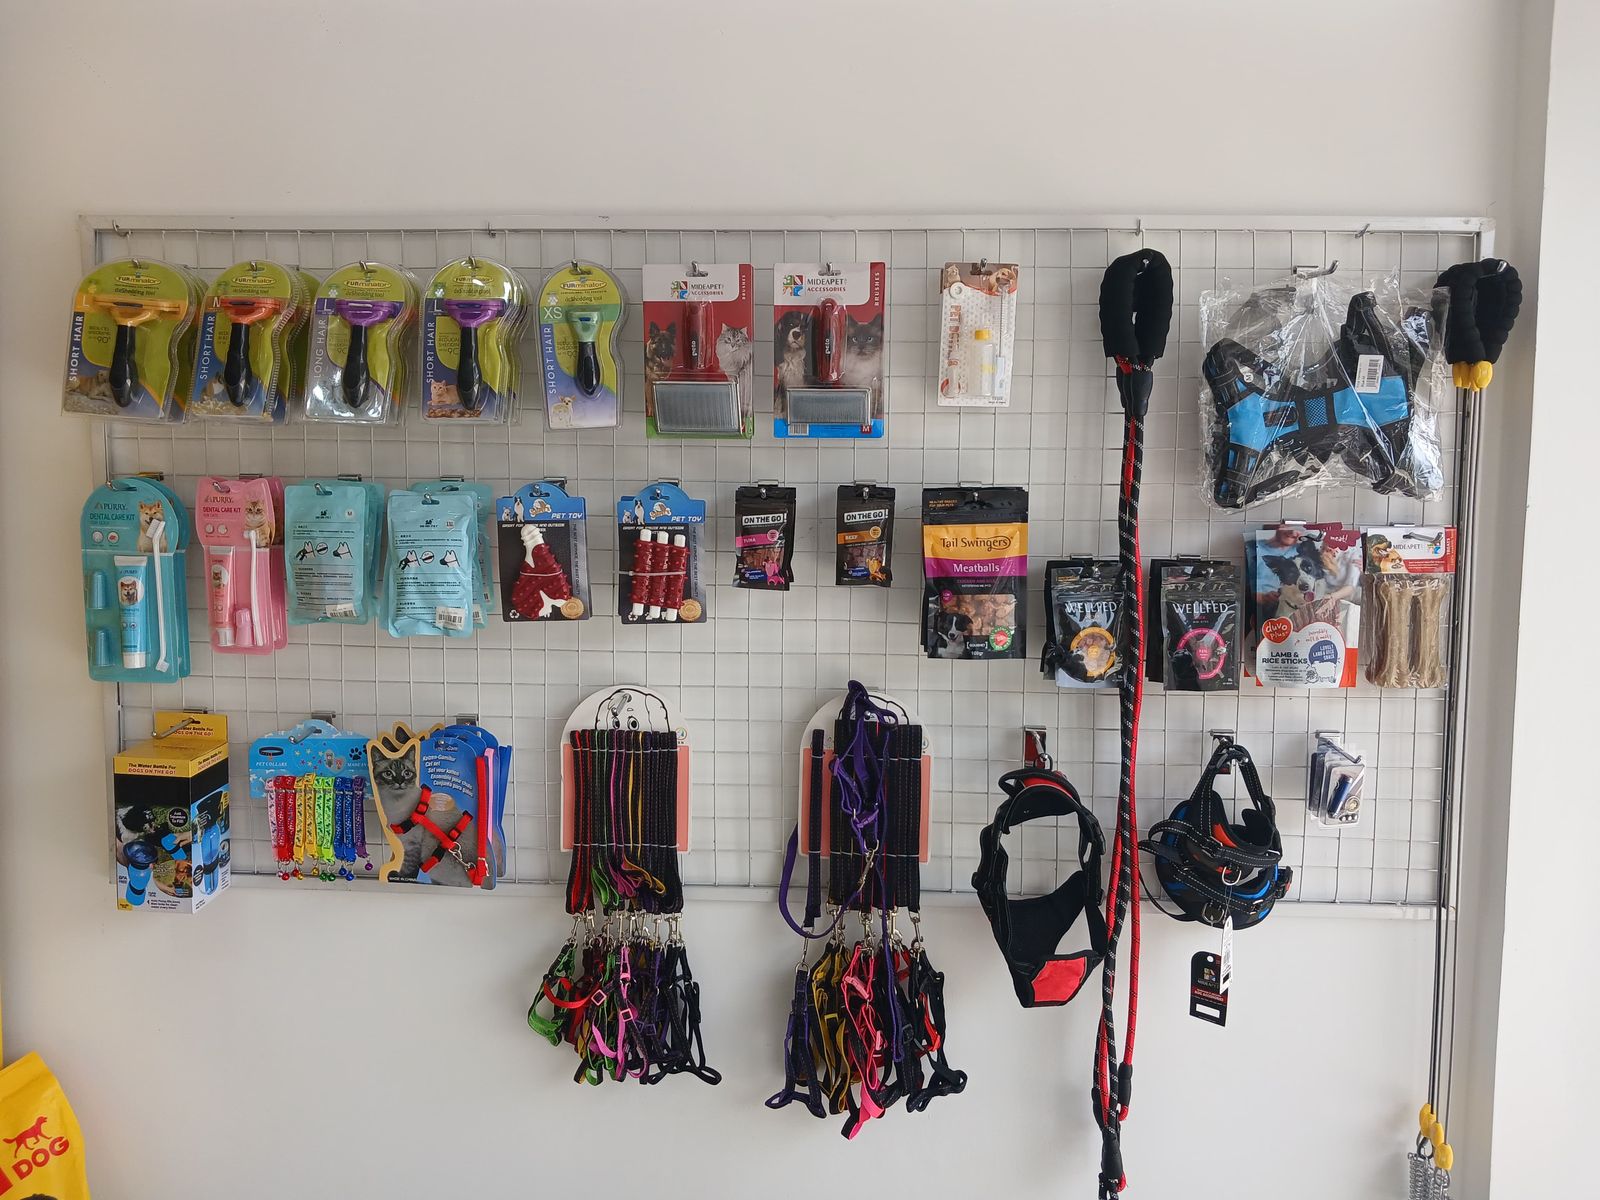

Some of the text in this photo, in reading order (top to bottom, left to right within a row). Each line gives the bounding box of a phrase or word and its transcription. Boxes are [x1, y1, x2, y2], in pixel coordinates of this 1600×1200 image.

[324, 299, 331, 311] L
[434, 300, 442, 311] L
[544, 306, 562, 319] XS
[69, 316, 83, 382] SHORT HAIR
[200, 316, 215, 380] SHORT HAIR
[314, 319, 326, 378] LONG HAIR
[544, 327, 556, 394] SHORT HAIR
[426, 352, 434, 383] SHORT
[940, 536, 1010, 552] Tail Swingers
[953, 563, 1000, 572] Meatballs
[1065, 602, 1117, 613] WELLFED
[1172, 603, 1228, 614] WELLFED
[1266, 622, 1288, 633] duvo
[1270, 632, 1285, 640] plus
[12, 1136, 69, 1180] DOG
